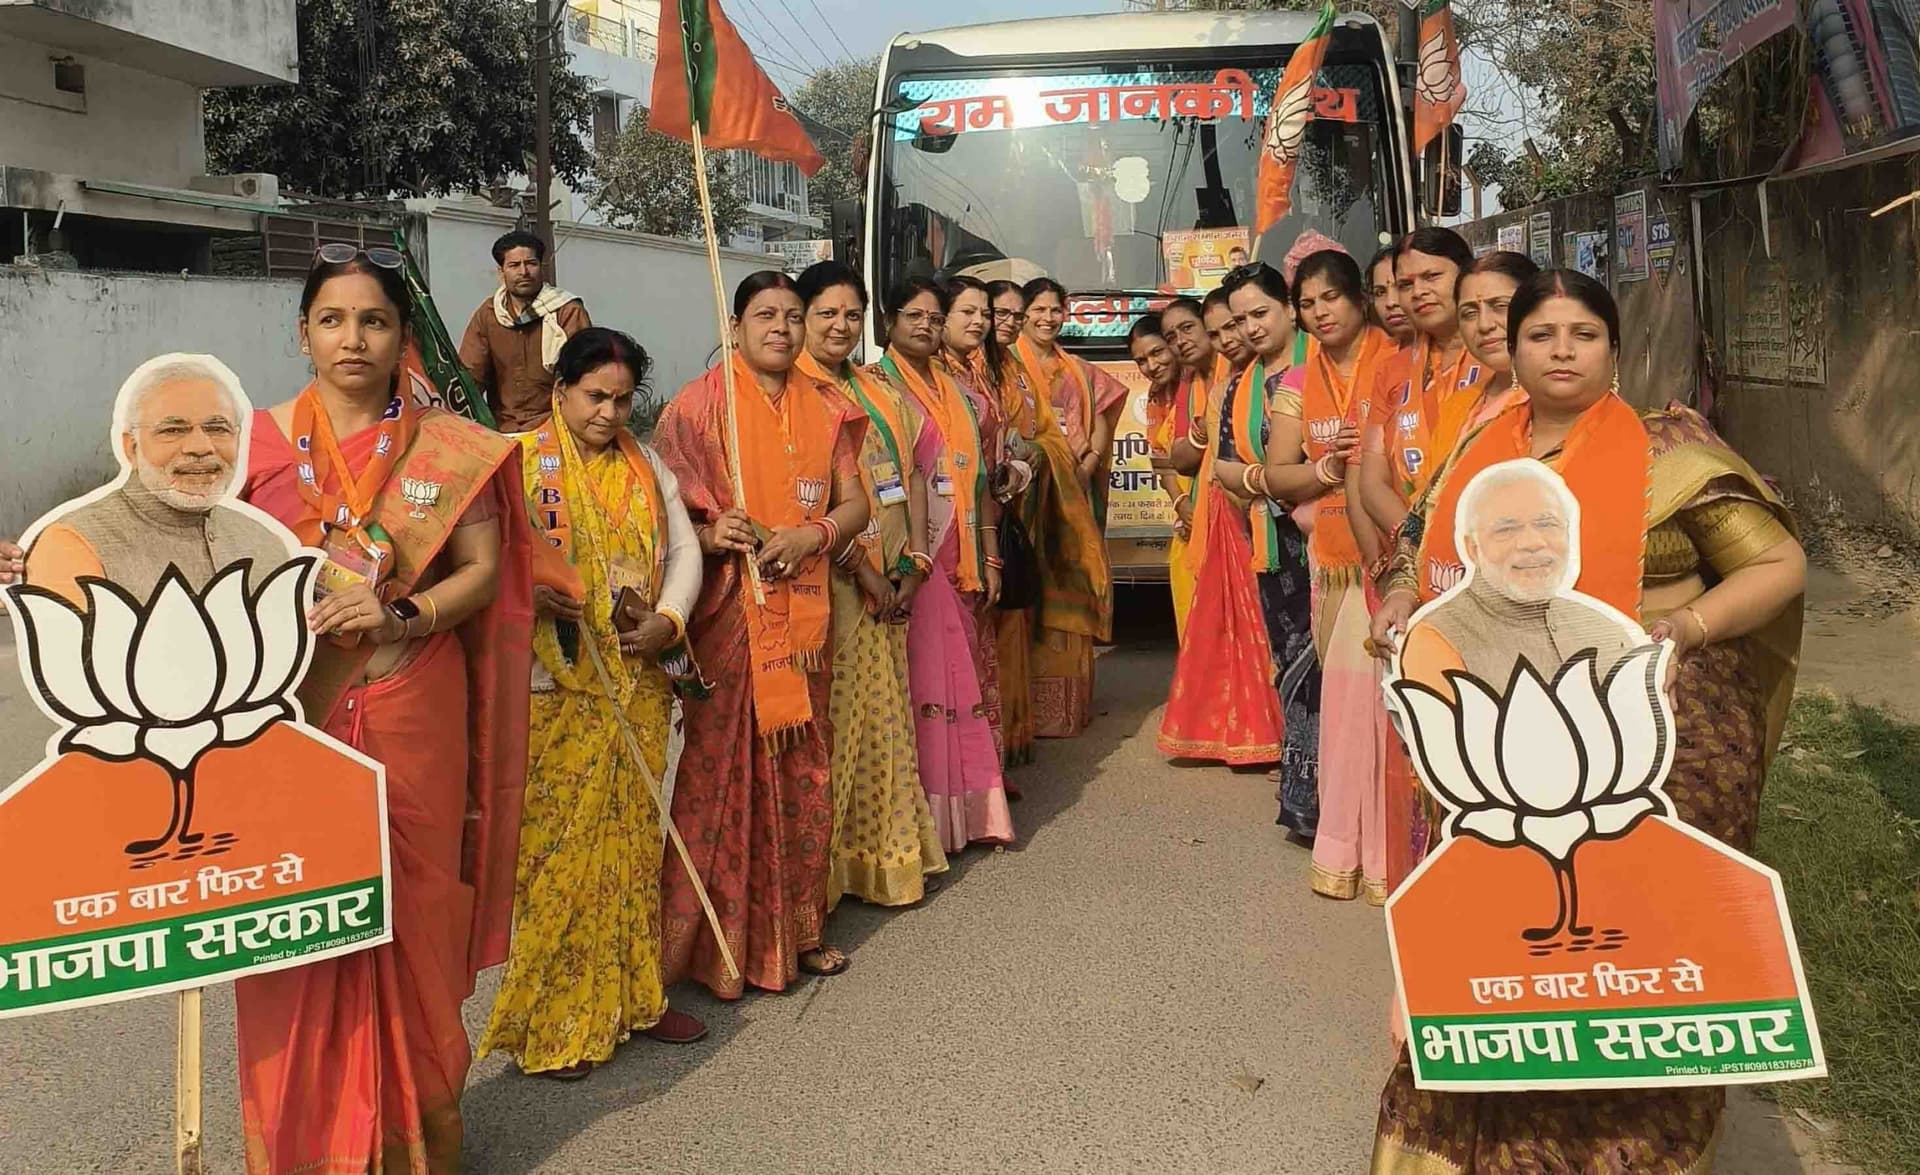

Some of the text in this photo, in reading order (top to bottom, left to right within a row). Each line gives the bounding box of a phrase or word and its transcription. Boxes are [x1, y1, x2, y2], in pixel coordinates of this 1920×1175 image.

[918, 95, 1014, 137] राम
[1040, 68, 1259, 124] जानकी
[1651, 223, 1670, 240] STS
[791, 585, 822, 597] भाजपा
[53, 853, 305, 926] एक बार फिर से
[184, 887, 376, 961] सरकार
[252, 949, 285, 964] Printed
[286, 948, 297, 958] by
[1469, 958, 1705, 1005] एक बार फिर से
[1420, 1009, 1796, 1065] भाजपा सरकार
[1665, 1064, 1699, 1075] Printed
[1700, 1064, 1713, 1076] by
